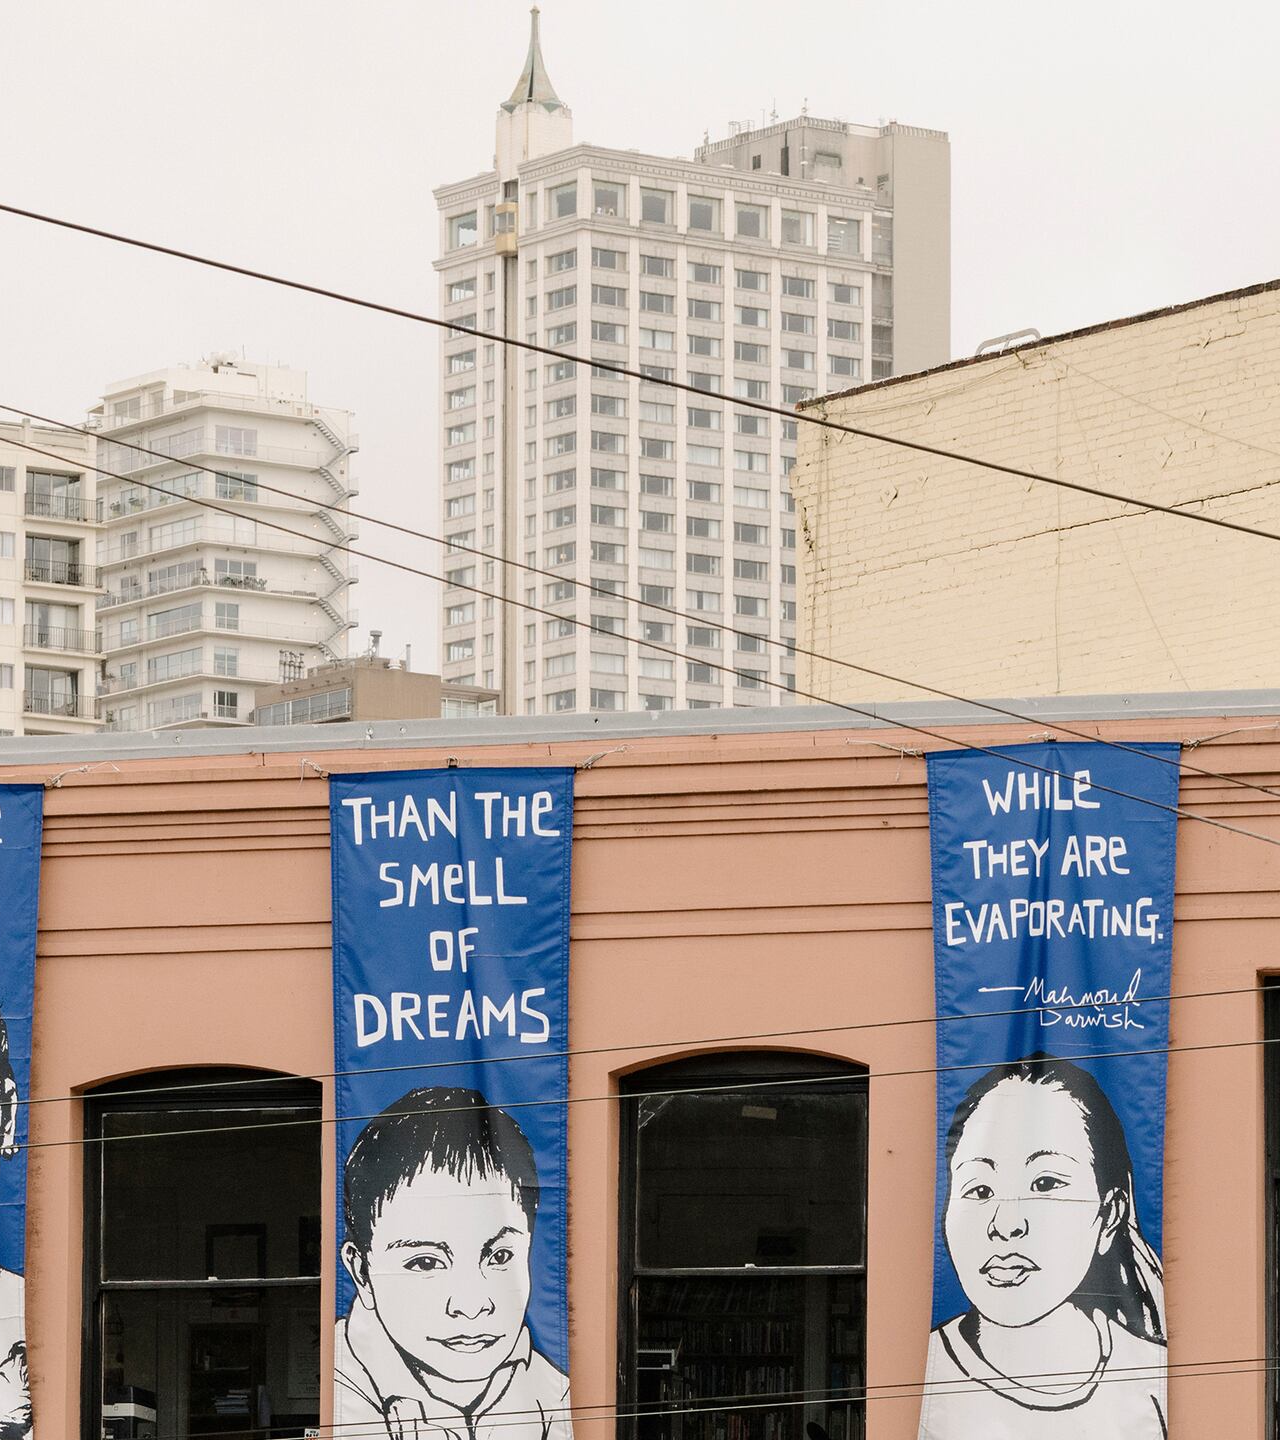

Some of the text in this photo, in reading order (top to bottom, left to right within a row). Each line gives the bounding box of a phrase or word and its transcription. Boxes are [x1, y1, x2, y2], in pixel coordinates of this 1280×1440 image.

[342, 793, 459, 846] THAN
[963, 837, 1050, 879] THEY
[430, 927, 479, 973] OF
[354, 988, 550, 1047] DREAMS
[1036, 1007, 1145, 1030] Darwish
